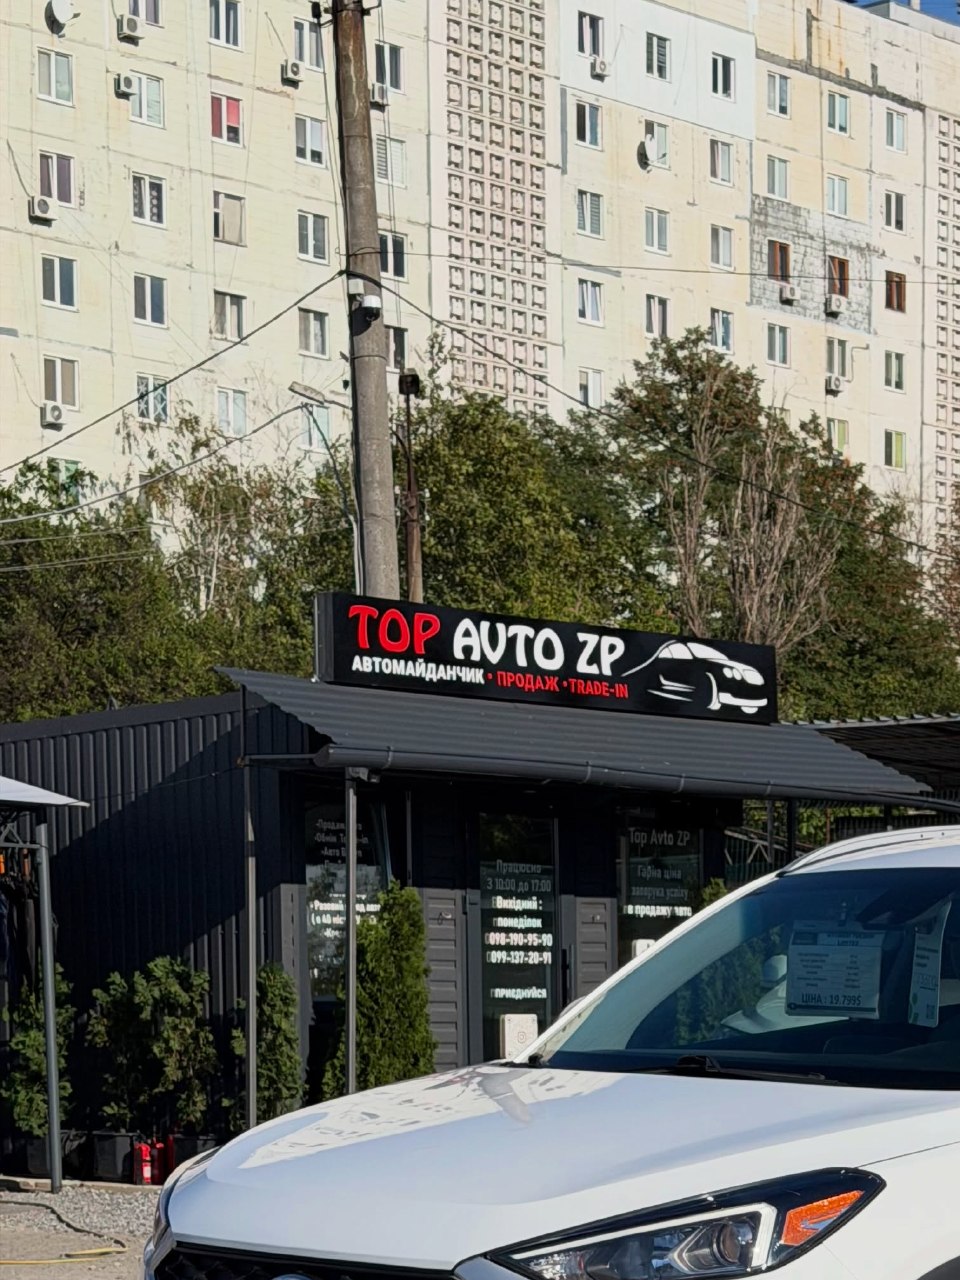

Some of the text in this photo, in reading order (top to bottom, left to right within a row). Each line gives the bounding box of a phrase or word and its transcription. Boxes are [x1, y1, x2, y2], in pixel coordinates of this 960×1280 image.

[347, 604, 441, 655] TOP
[576, 633, 625, 677] ZP
[352, 655, 629, 699] АВТОМАЙДАНЧИК ПРОДАЖ TRADE-IN
[627, 827, 691, 847] Top Avto ZP
[495, 878, 516, 890] 10:00
[517, 881, 529, 893] до
[531, 879, 552, 892] 17:00
[490, 950, 552, 965] 099-137-20-91
